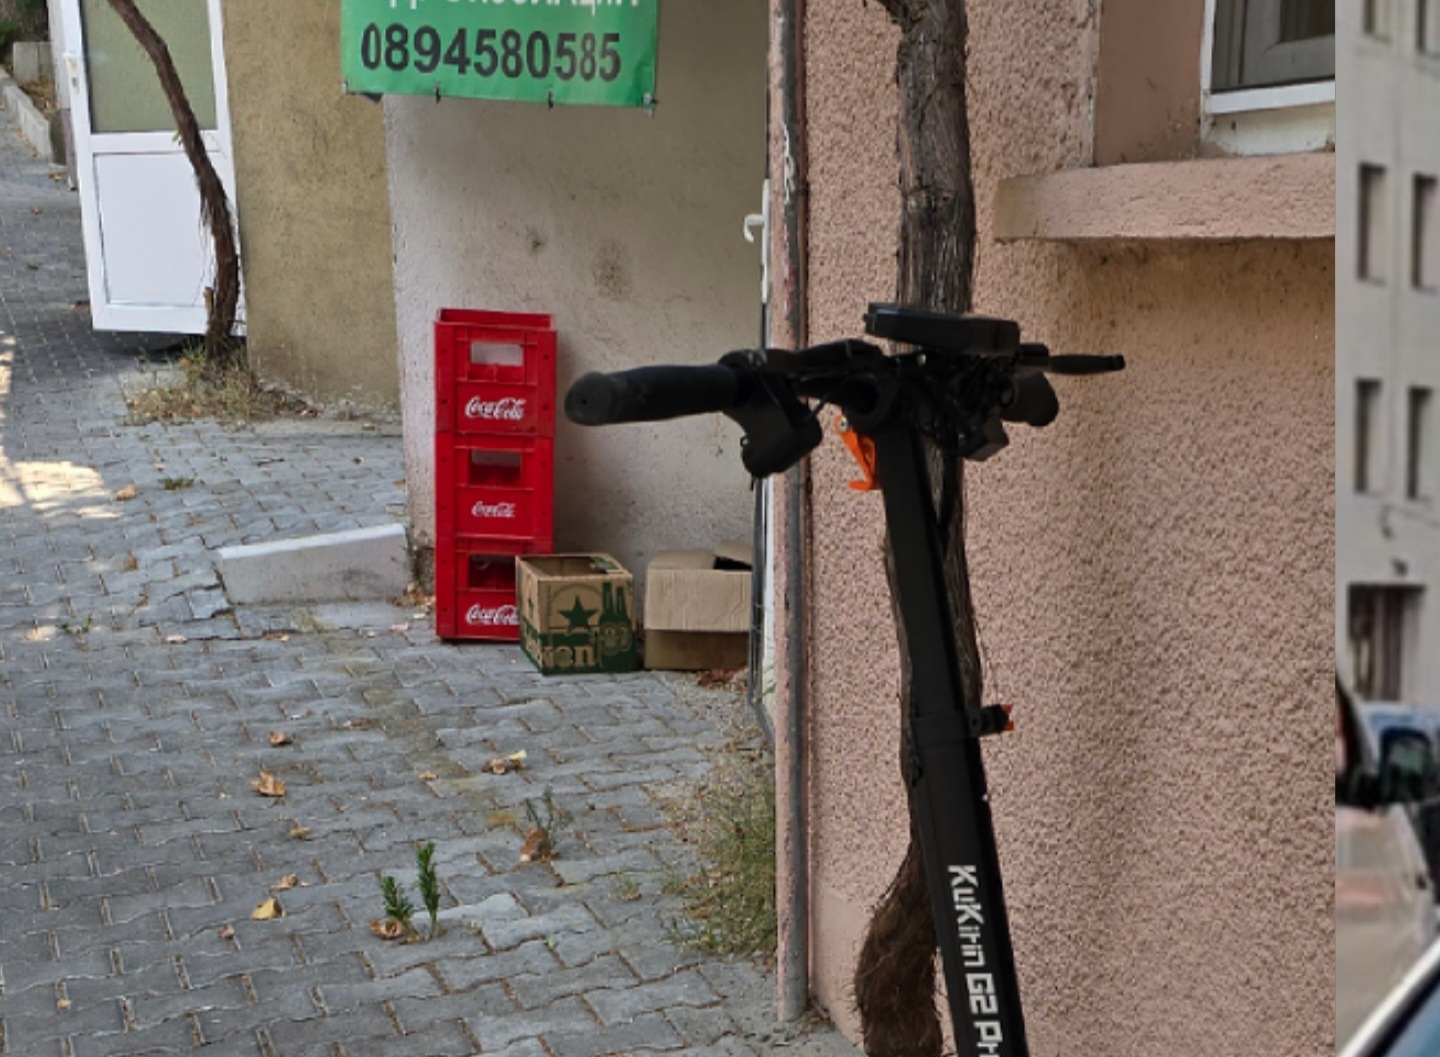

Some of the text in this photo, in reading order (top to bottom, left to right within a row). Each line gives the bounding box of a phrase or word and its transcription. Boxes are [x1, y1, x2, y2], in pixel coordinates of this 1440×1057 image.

[361, 22, 621, 83] 0894580585
[948, 864, 985, 968] KuKirin
[965, 972, 999, 1015] G2
